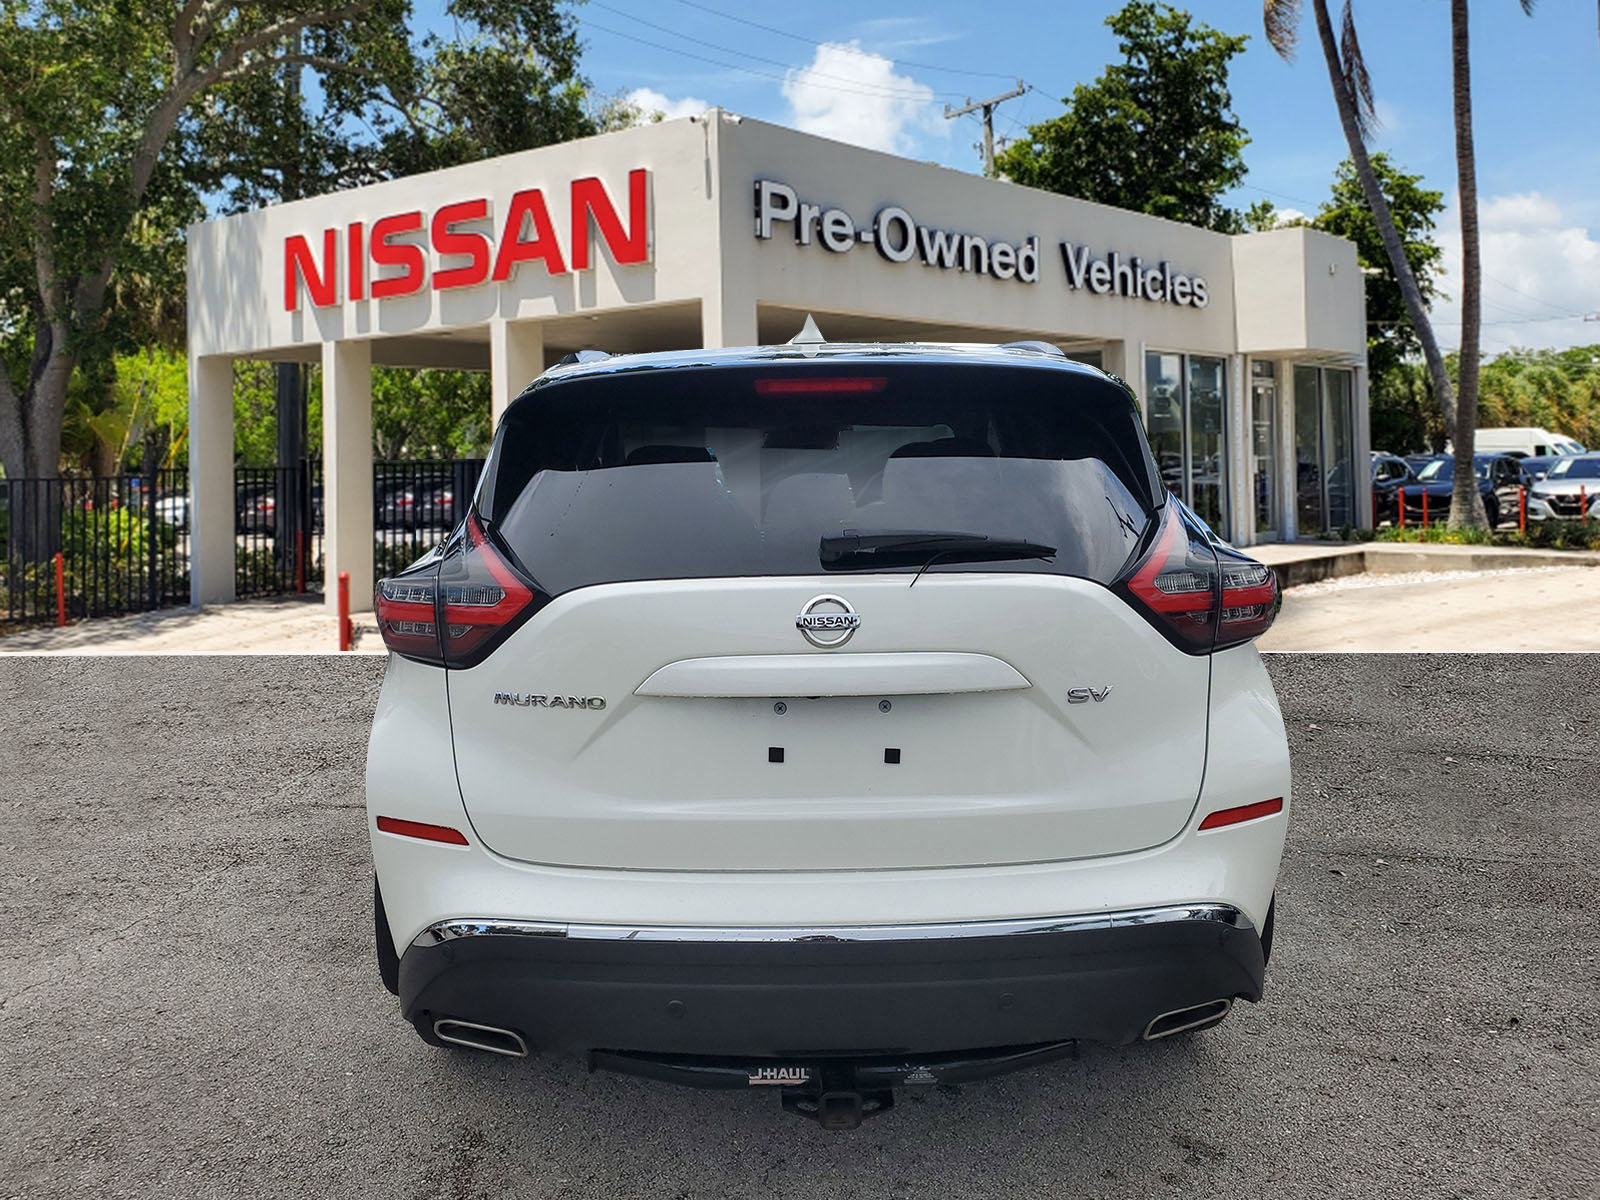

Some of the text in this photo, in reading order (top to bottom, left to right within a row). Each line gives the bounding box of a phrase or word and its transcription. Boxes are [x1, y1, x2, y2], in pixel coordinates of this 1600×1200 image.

[285, 168, 650, 312] NISSAN
[754, 179, 1209, 308] Pre-Owned Vehicles
[803, 616, 853, 625] NISSAN
[494, 692, 606, 710] MURANO
[1067, 686, 1113, 704] SV
